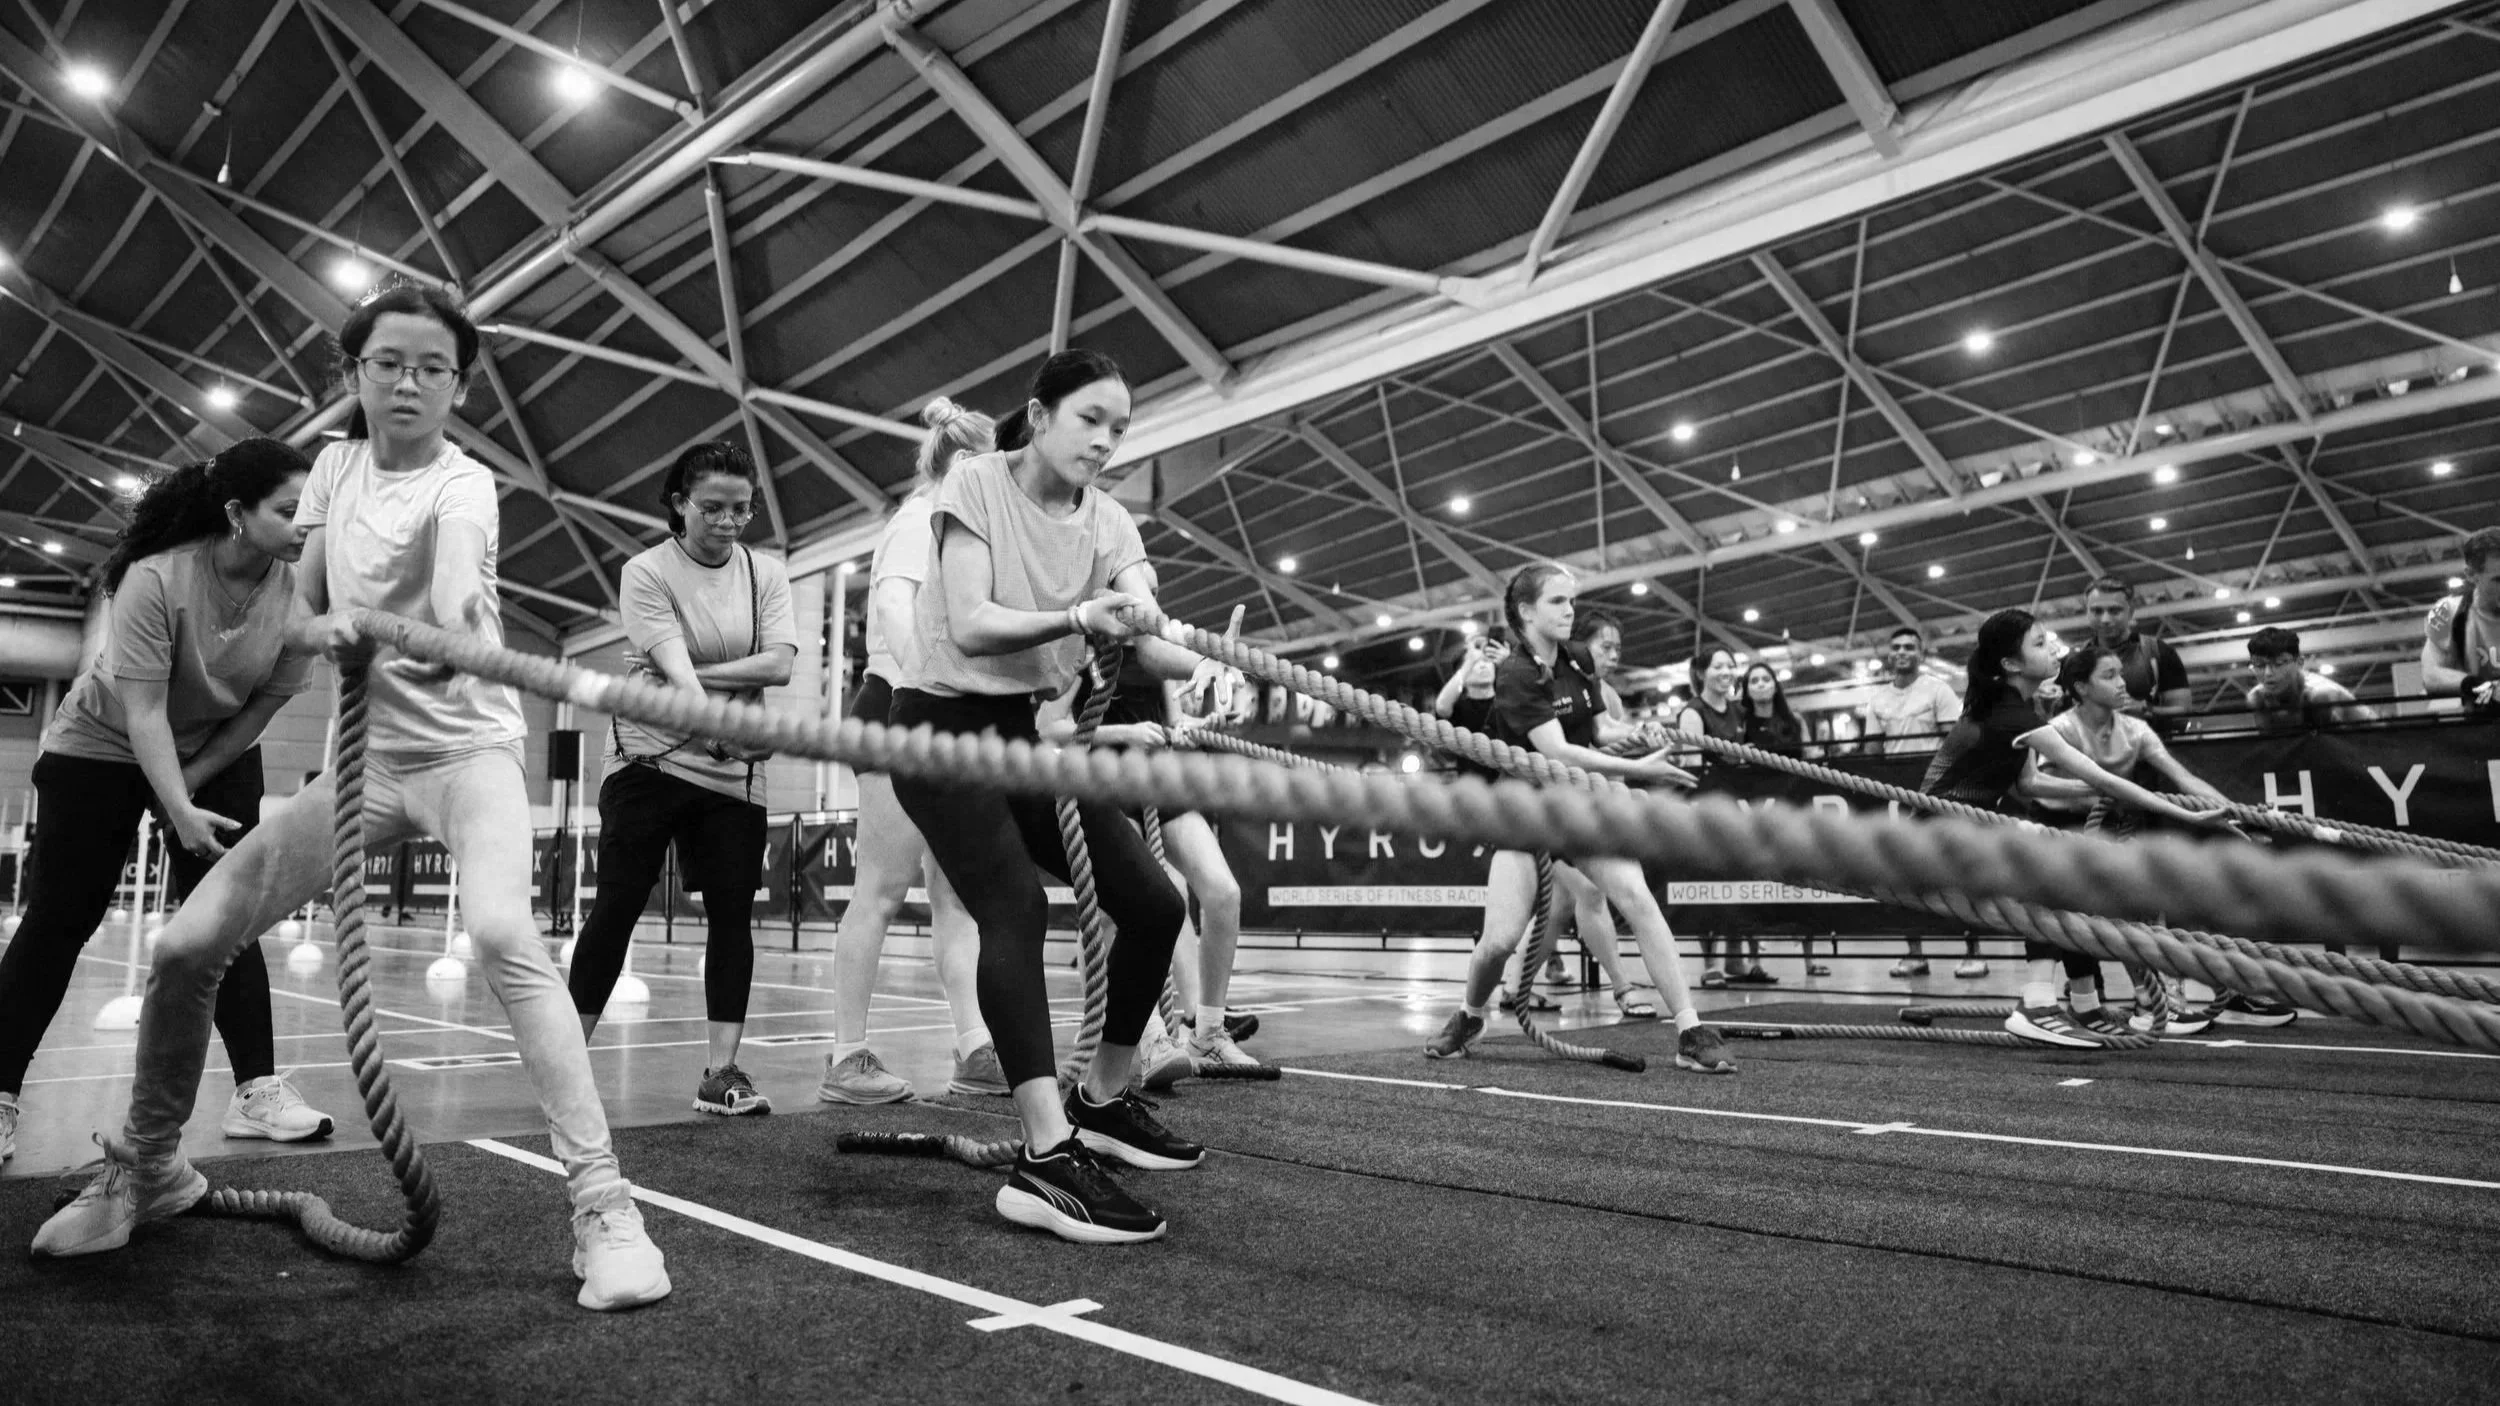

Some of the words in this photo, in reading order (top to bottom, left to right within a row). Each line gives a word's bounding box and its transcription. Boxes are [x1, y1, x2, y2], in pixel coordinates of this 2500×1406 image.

[1268, 821, 1485, 859] HYRO
[414, 853, 452, 874] HYRO
[1319, 888, 1362, 902] SERIES
[1367, 888, 1384, 902] OF
[1388, 888, 1442, 902] FITNESS
[1671, 884, 1733, 899] WORLD
[1739, 883, 1804, 900] SERIES
